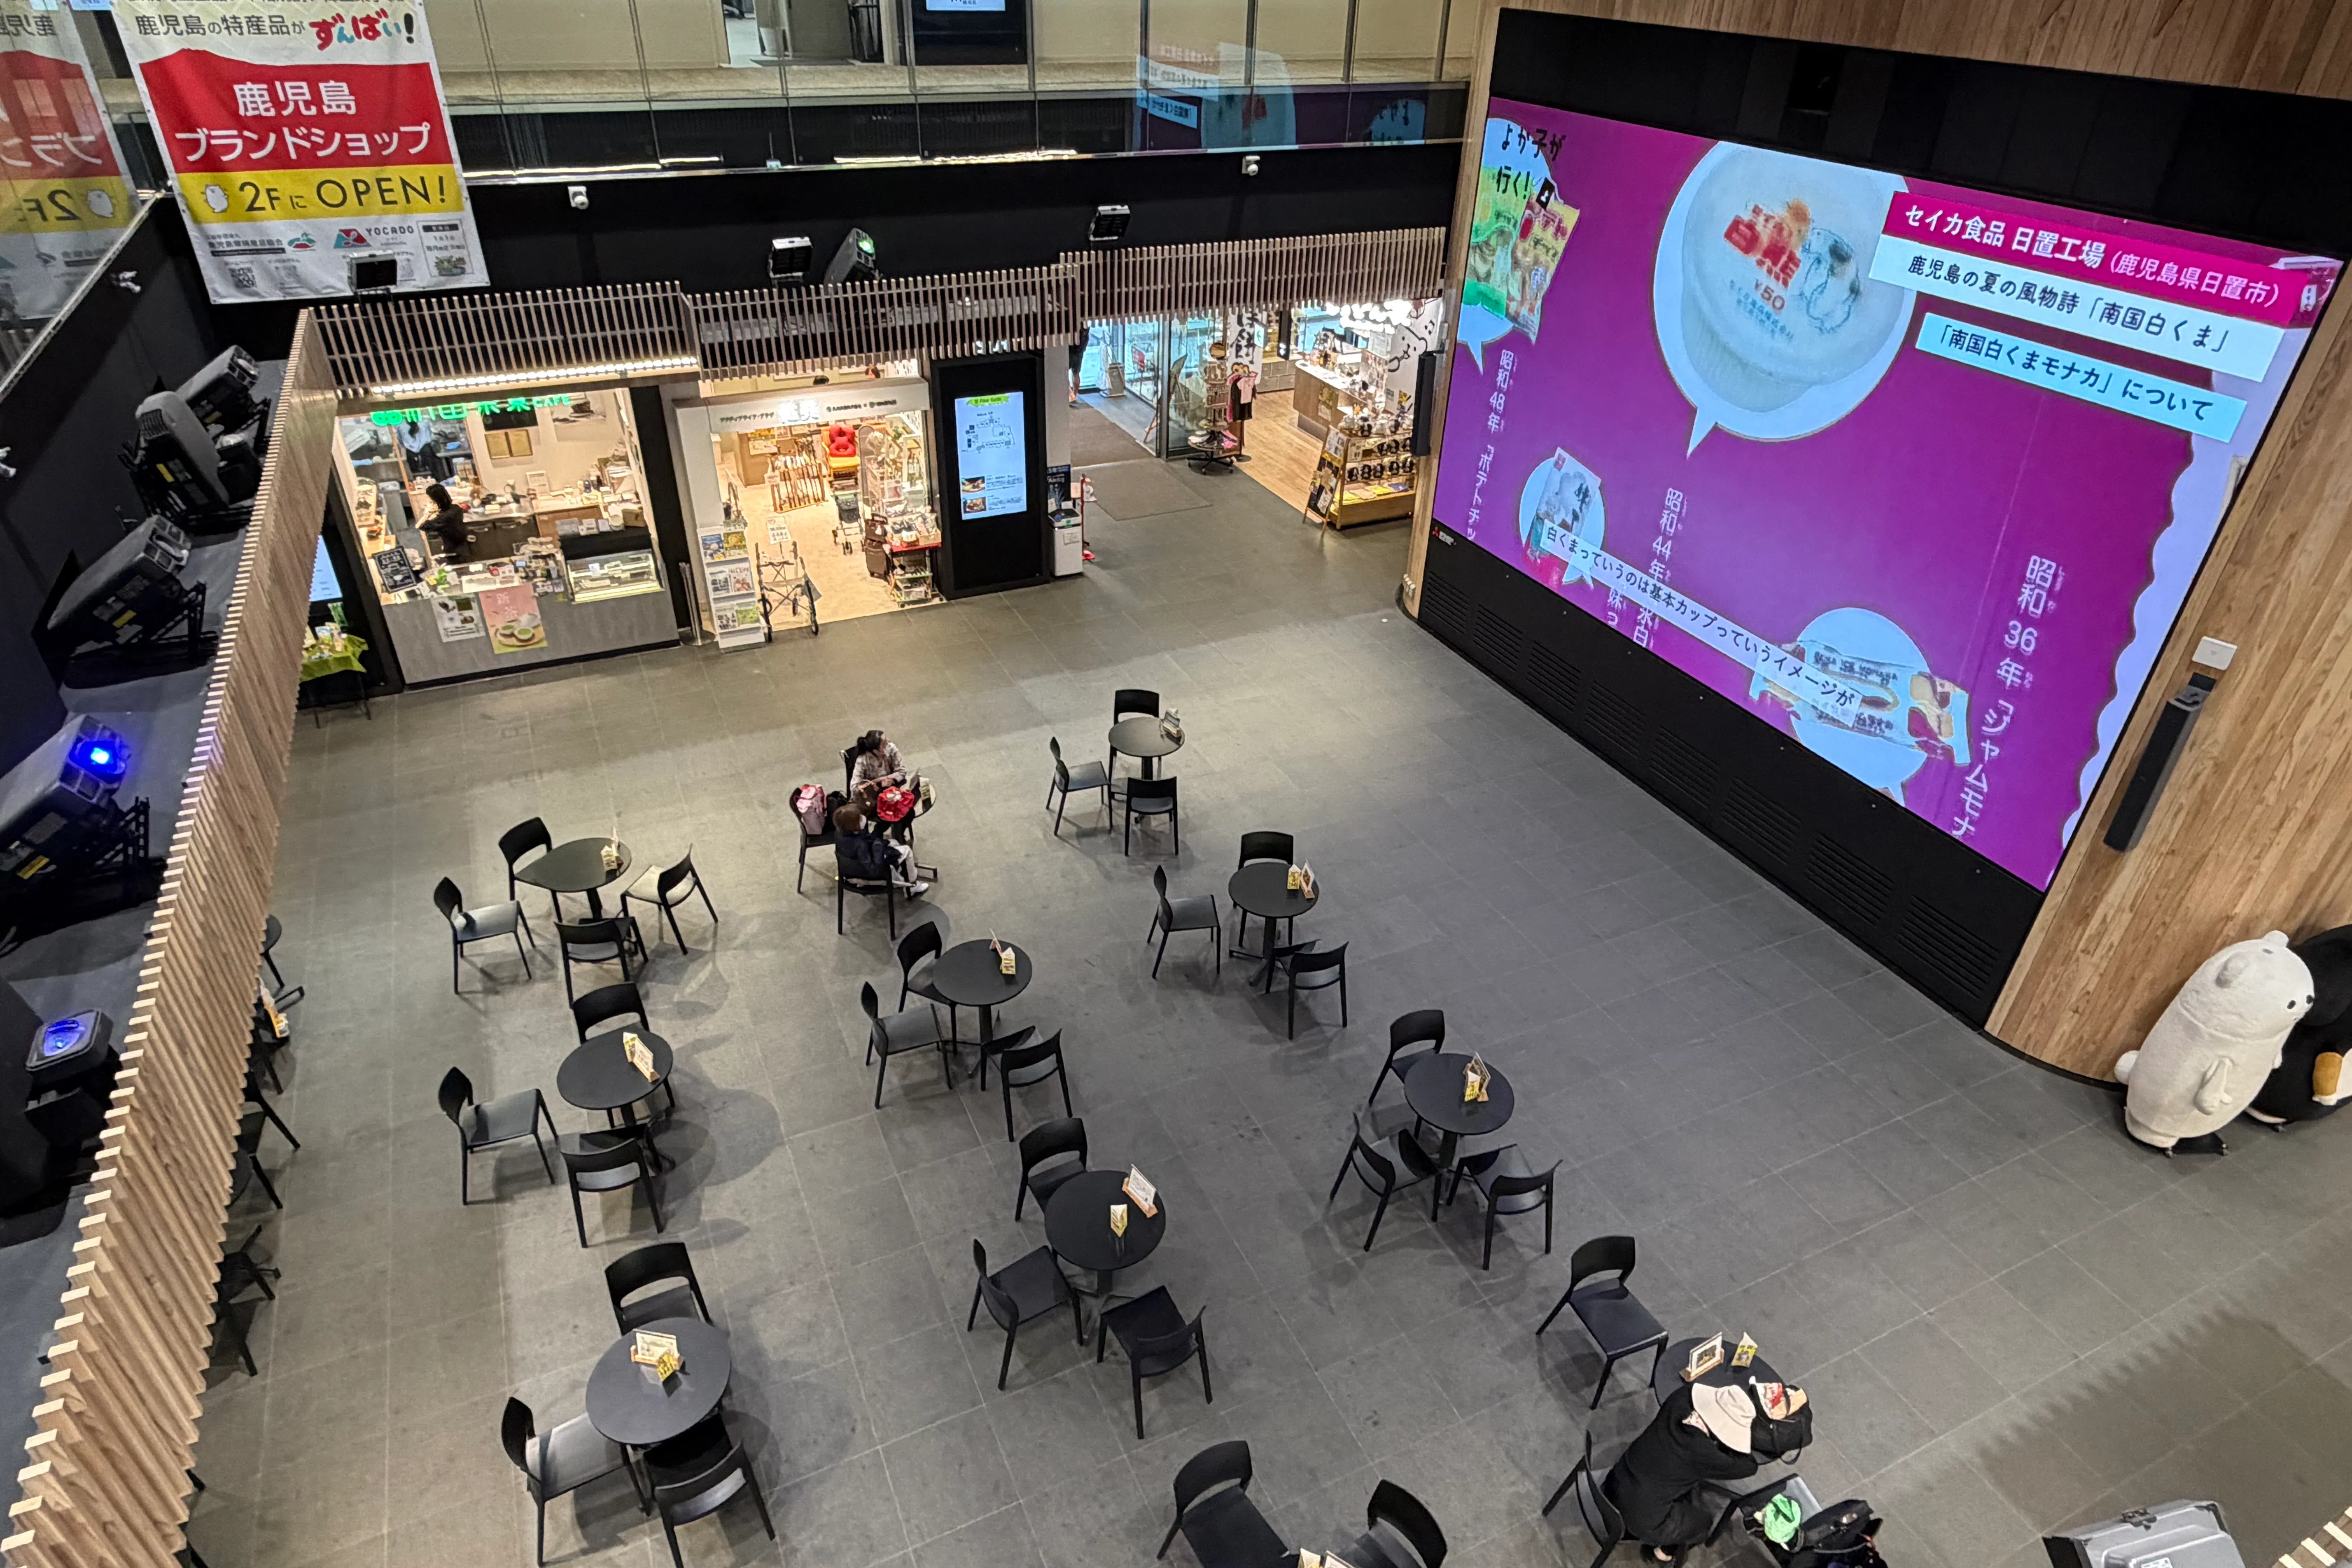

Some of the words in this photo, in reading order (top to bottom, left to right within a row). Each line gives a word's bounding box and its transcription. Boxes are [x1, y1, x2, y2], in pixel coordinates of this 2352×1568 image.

[135, 15, 305, 36] 鹿児島の特産品が
[175, 121, 430, 162] ブランドショップ
[234, 80, 356, 118] 鹿児島
[1496, 166, 1529, 199] 行く!
[1501, 124, 1566, 161] よか子が
[239, 182, 280, 213] 2F
[289, 194, 308, 209] に
[316, 175, 447, 208] OPEN!
[366, 226, 414, 236] YOCADO
[1906, 205, 2005, 247] セイカ食品
[2011, 226, 2106, 269] 日置工場
[2110, 251, 2279, 308] (鹿児島県日置市)
[1908, 255, 2229, 352] 鹿児島の夏の風物詩「南国白くま」
[1488, 349, 1514, 434] 昭和48年
[1940, 324, 2213, 421] 「南国白くまモナカ」について
[1649, 488, 1683, 581] 昭和44年
[1546, 526, 1856, 707] 白くまっていうのは基本カップっていうイメージが
[1997, 555, 2056, 690] 昭和36年
[1952, 700, 2014, 837] ジャムモナ
